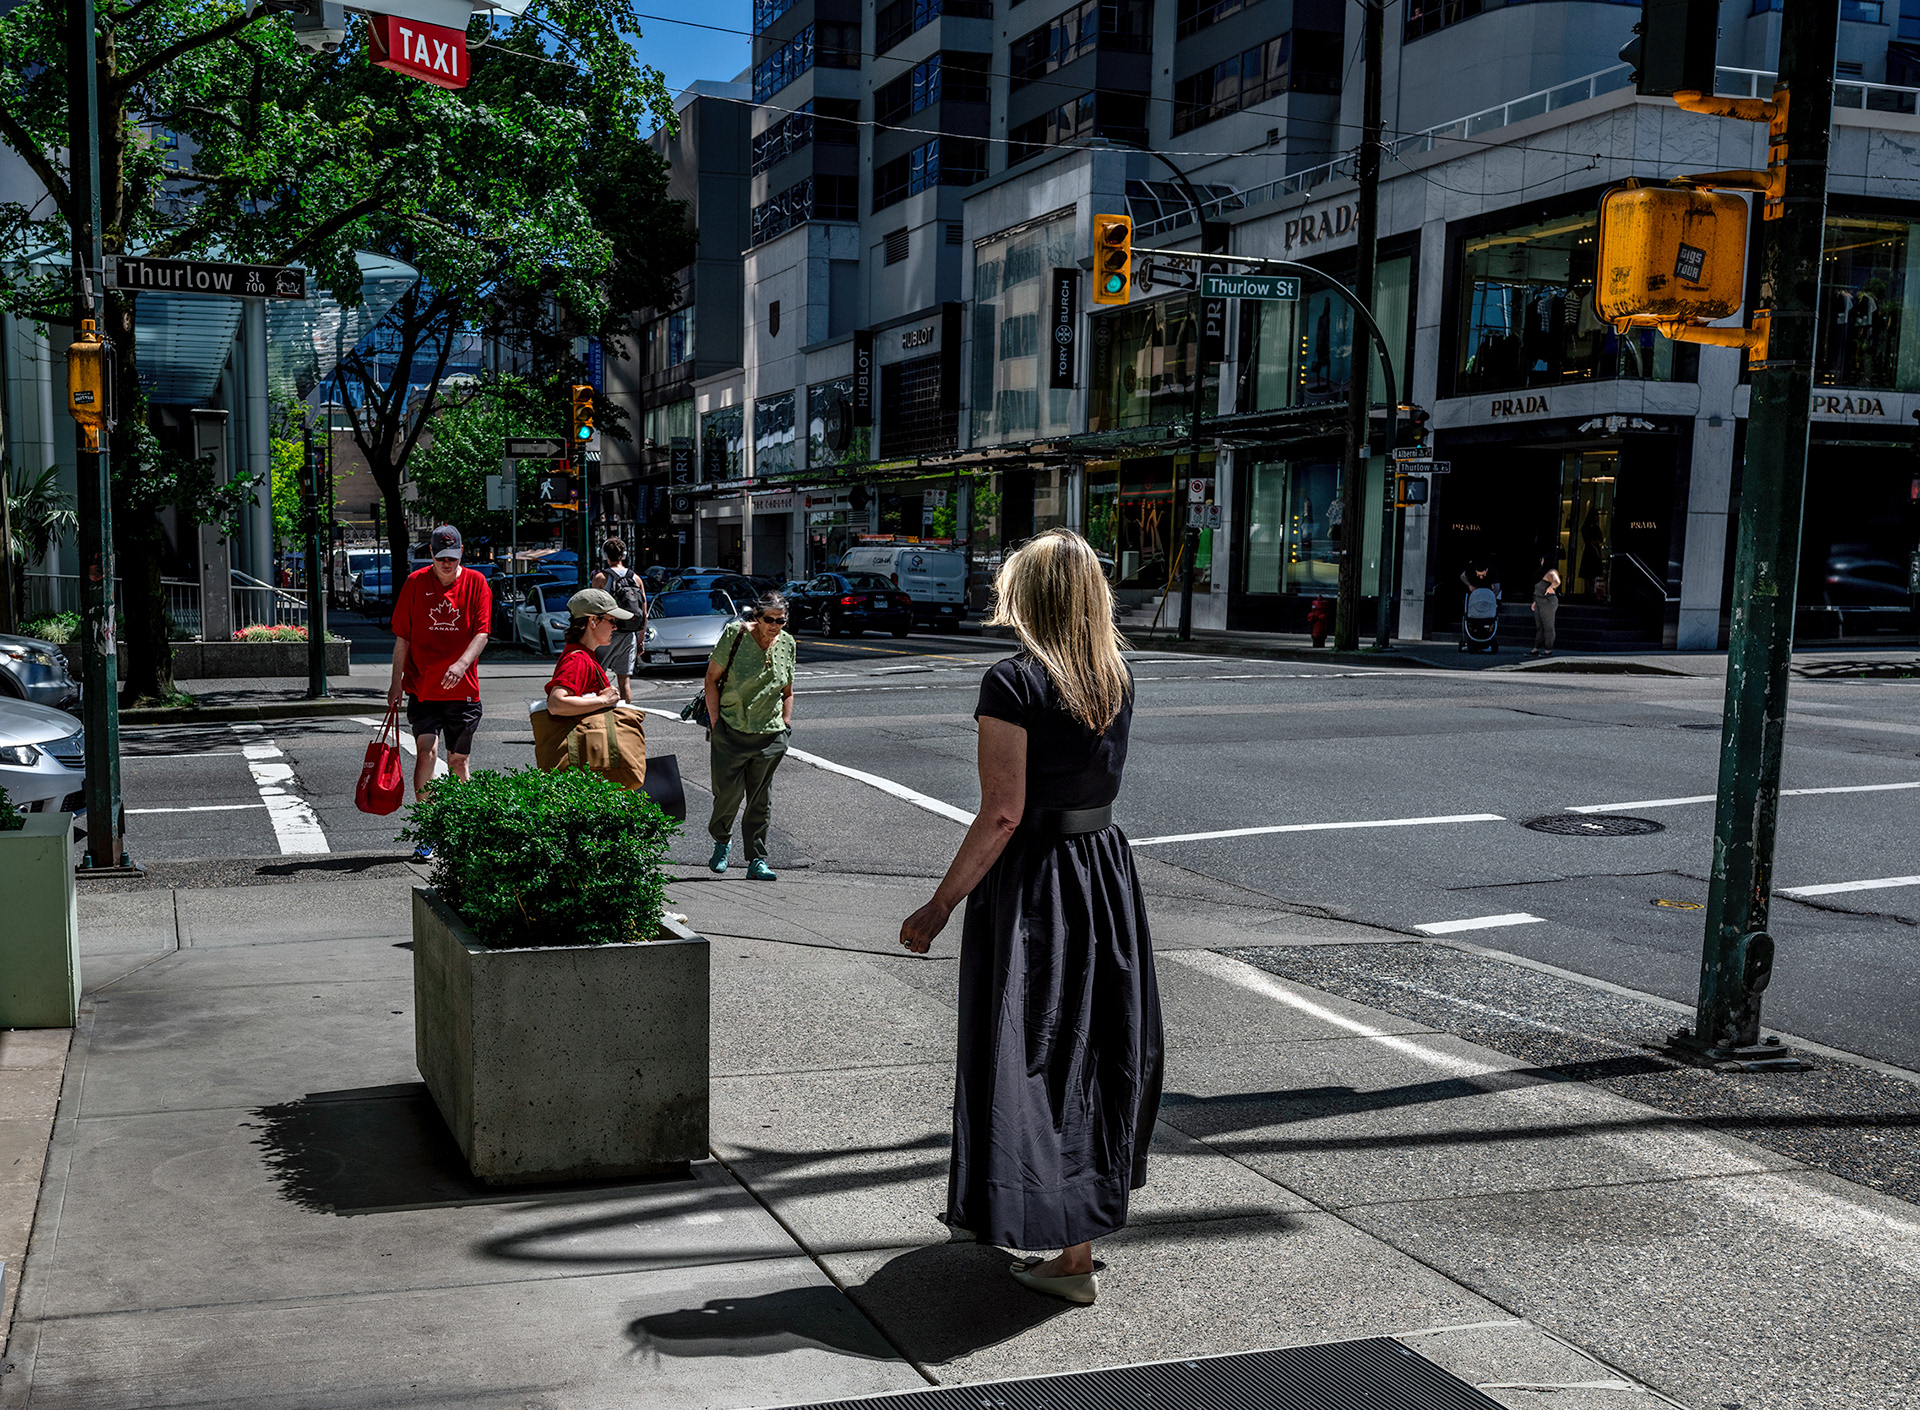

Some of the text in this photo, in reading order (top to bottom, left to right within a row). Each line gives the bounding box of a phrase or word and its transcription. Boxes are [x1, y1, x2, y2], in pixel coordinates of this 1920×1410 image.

[399, 26, 458, 77] TAXI
[124, 262, 233, 291] Thurlow
[244, 281, 266, 293] 700
[248, 271, 260, 283] St
[1208, 278, 1299, 297] Thurlow St
[902, 326, 934, 348] HUBLOT
[1058, 280, 1070, 377] TORY BURCH
[858, 348, 869, 407] HUBLOT
[1491, 394, 1549, 417] PRADA
[1811, 395, 1885, 416] PRADA
[1397, 448, 1418, 458] Alberni
[675, 450, 687, 482] ARK
[1400, 462, 1431, 472] Thurlow
[1630, 520, 1657, 529] PRADA
